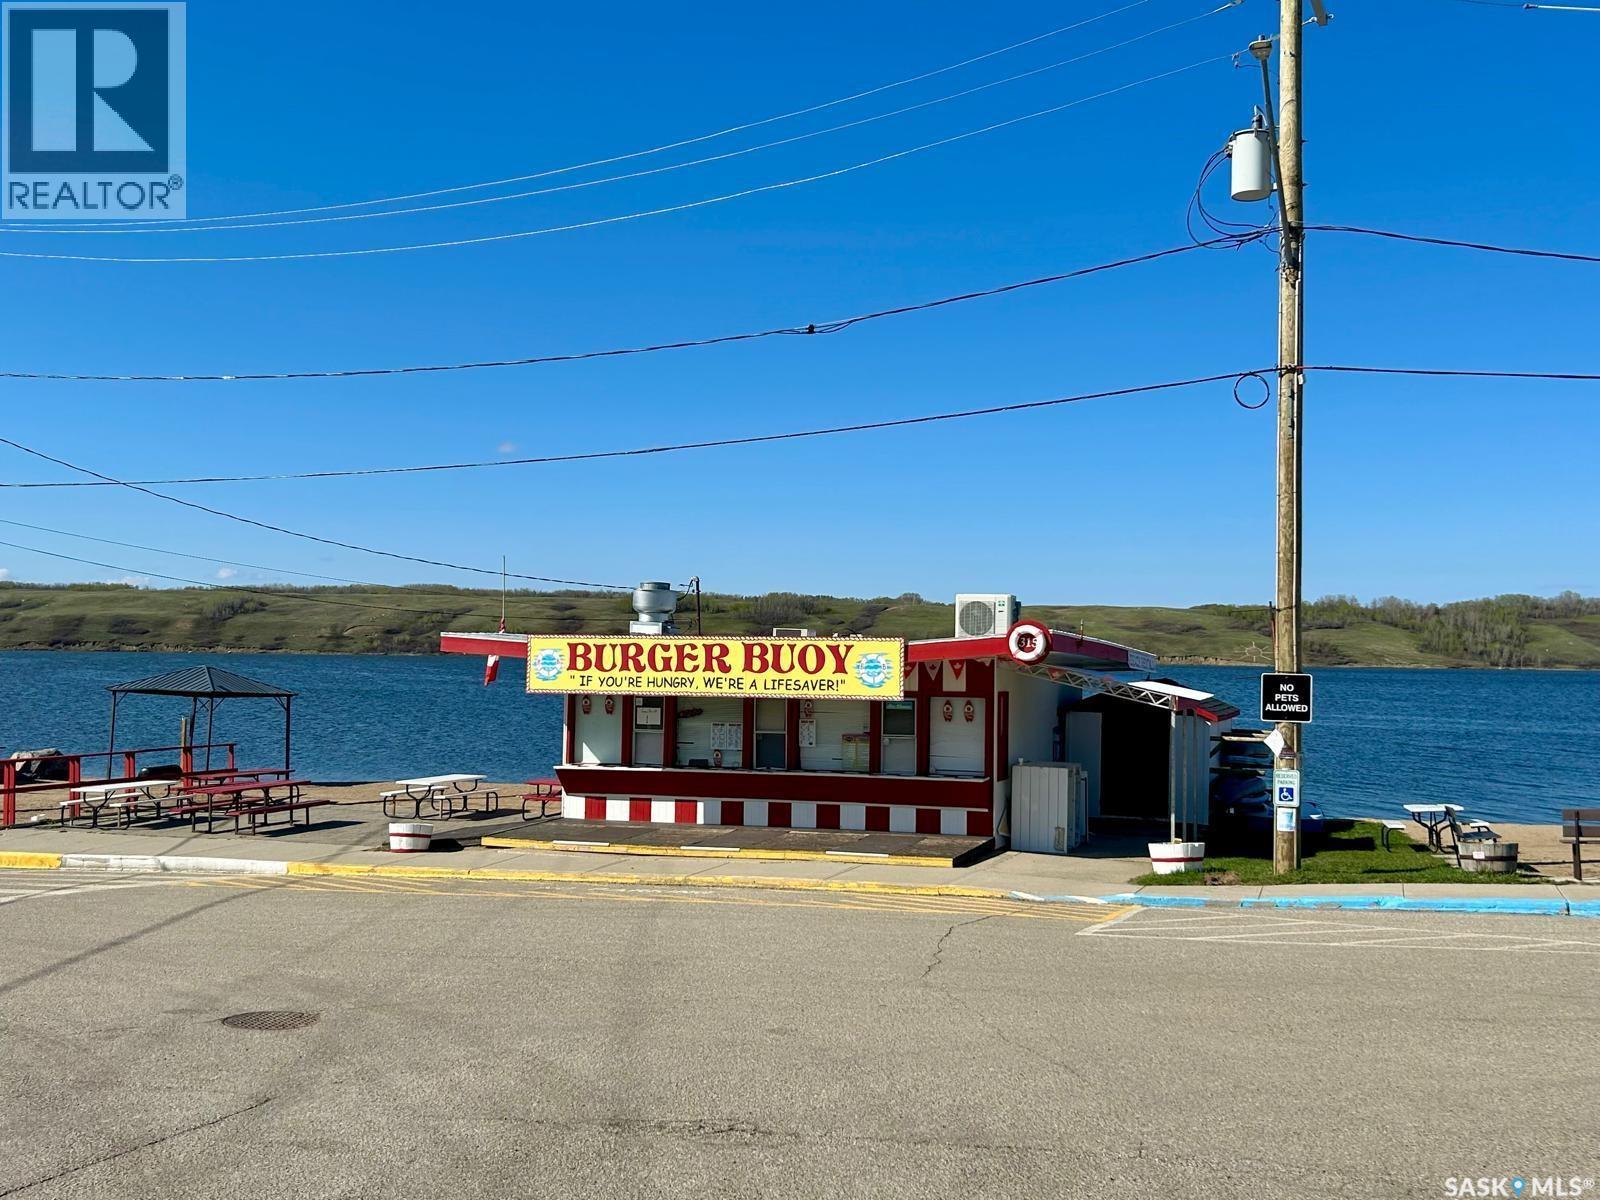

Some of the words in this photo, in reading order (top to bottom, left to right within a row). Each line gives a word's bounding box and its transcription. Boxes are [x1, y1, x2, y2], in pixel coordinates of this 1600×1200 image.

[567, 642, 732, 673] BURGER
[742, 642, 854, 675] BUOY
[599, 675, 642, 687] YOU'RE
[646, 677, 699, 690] HUNGRY,
[703, 677, 744, 690] WE'RE
[749, 679, 758, 690] A
[1280, 683, 1294, 692] NO
[1274, 693, 1299, 702] PETS
[1265, 703, 1308, 712] ALLOWED
